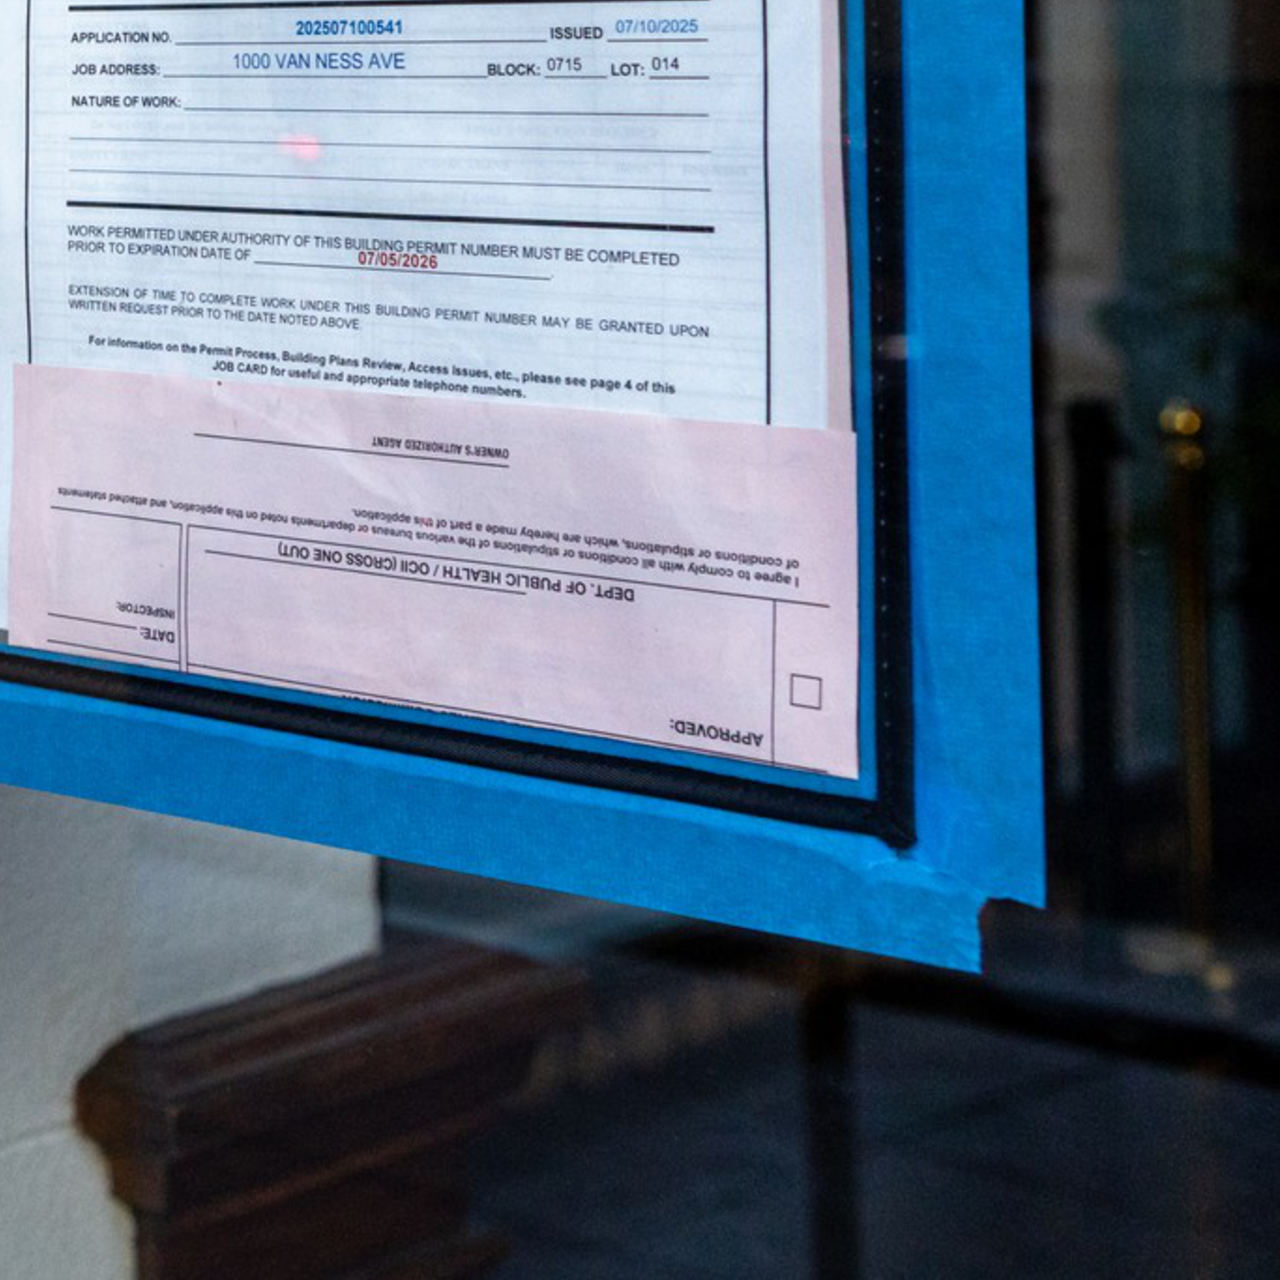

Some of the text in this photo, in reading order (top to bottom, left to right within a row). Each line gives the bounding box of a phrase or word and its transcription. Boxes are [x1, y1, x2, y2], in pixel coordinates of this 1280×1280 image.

[70, 19, 699, 44] APPLICATION NO. 202507100541 ISSUED 07/10/2025
[71, 52, 680, 77] JOB ADDRESS: 1000 VAN NESS AVE BLOCK: 0715 LOT: 014
[71, 96, 181, 108] NATURE OF WORK:
[66, 226, 680, 267] WORK PERMITTED UNDER AUTHORITY OF THIS BUILDING PERMIT NUMBER MUST BE COMPLETED
[67, 241, 438, 269] PRIOR TO EXPIRATION DATE OF 07/05/2026
[67, 285, 709, 338] EXTENSION OF TIME TO COMPLETE WORK UNDER THIS BUILDING PERMIT NUMBER MAY BE GRANTED UPON
[67, 300, 117, 312] WRITTEN
[118, 303, 169, 316] REQUEST
[170, 305, 204, 318] PRIOR
[206, 309, 222, 320] TO
[223, 310, 245, 322] THE
[246, 312, 276, 324] DATE
[278, 314, 318, 327] NOTED
[87, 336, 106, 346] For
[107, 339, 164, 351] information
[165, 344, 179, 352] on
[180, 344, 197, 354] the
[198, 344, 233, 357] Permit
[234, 348, 280, 362] Process,
[281, 352, 326, 368] Building
[328, 355, 360, 368] Plans
[361, 358, 406, 373] Review,
[407, 362, 449, 375] Access
[451, 366, 492, 380] Issues,
[521, 372, 562, 385] please
[564, 378, 587, 387] see
[589, 380, 621, 392] page
[623, 380, 633, 390] 4
[635, 382, 649, 392] of
[651, 383, 676, 395] this
[371, 436, 510, 460] OWNER'S AUTHORIZED AGENT
[278, 541, 311, 560] OUT)
[313, 548, 343, 564] ONE
[345, 552, 398, 571] (CROSS
[400, 560, 431, 576] OCII
[442, 565, 502, 585] HEALTH
[505, 572, 562, 592] PUBLIC
[565, 581, 588, 595] OF
[590, 583, 635, 602] DEPT.
[140, 627, 175, 644] DATE:
[670, 719, 765, 747] APPROVED:
